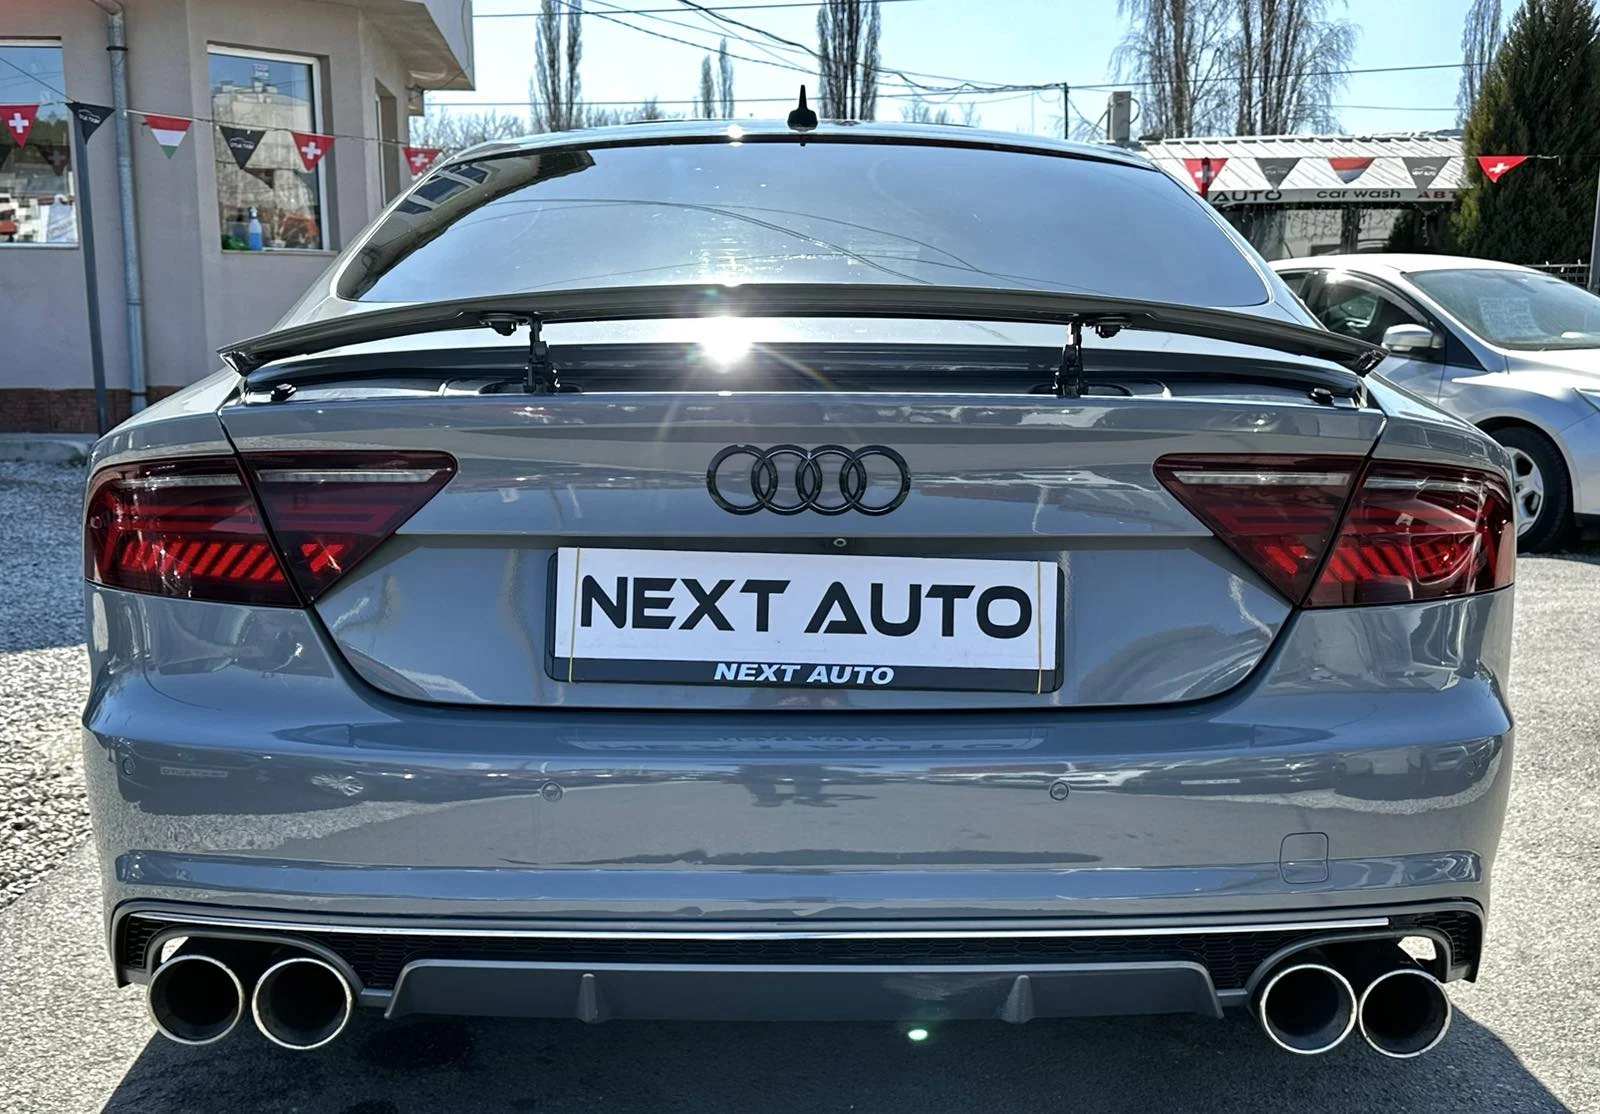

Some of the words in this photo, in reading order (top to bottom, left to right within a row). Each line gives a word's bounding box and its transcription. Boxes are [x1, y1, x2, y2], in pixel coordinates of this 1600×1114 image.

[1213, 190, 1282, 202] AUTO
[1316, 190, 1348, 199] car
[1354, 189, 1401, 199] wash
[580, 574, 791, 633] NEXT
[804, 581, 1033, 640] AUTO
[713, 663, 801, 683] NEXT
[806, 665, 895, 686] AUTO
